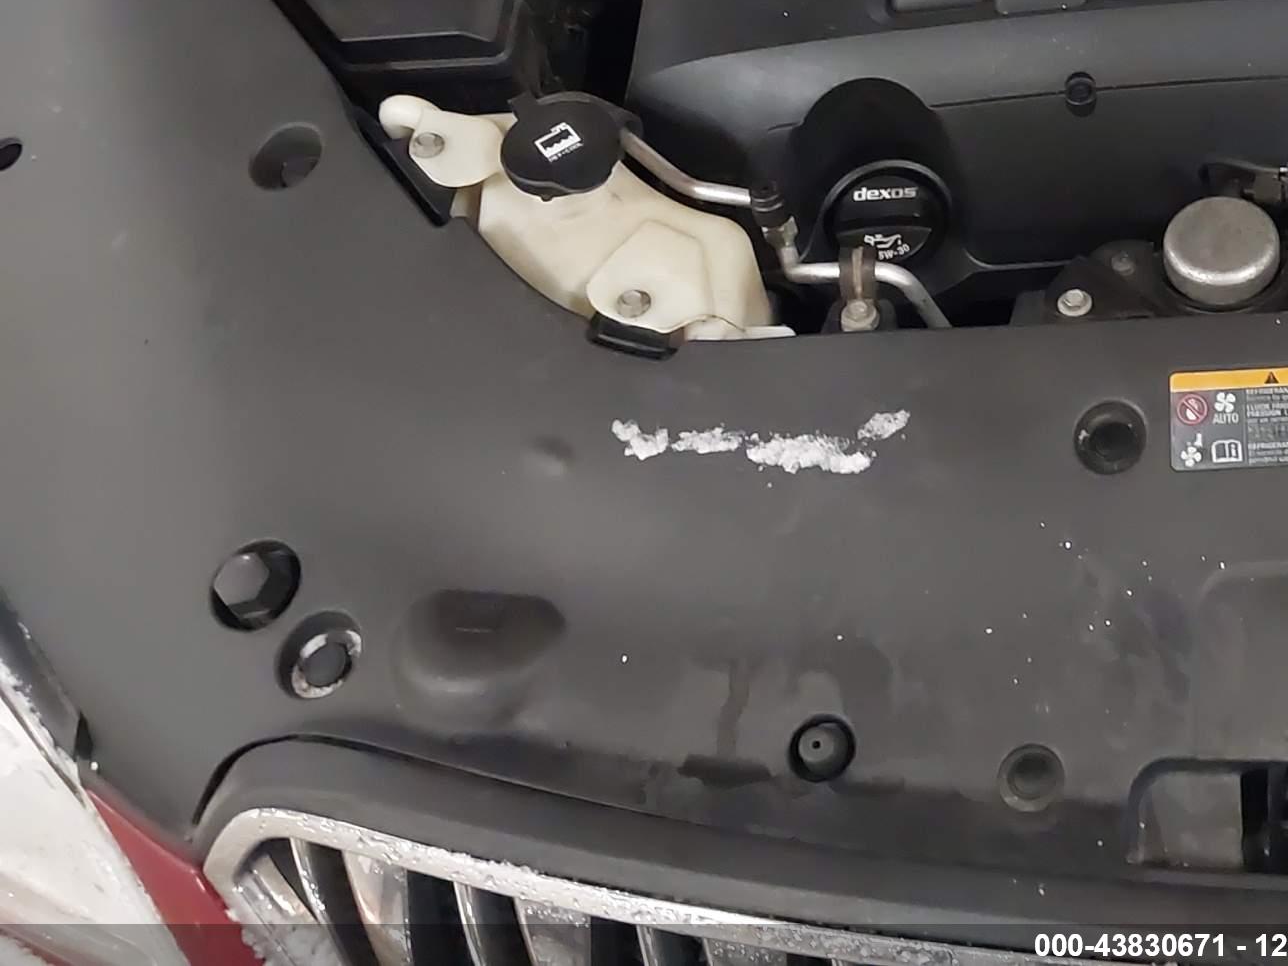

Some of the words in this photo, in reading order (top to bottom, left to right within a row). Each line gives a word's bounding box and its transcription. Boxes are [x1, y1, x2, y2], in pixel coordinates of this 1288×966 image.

[853, 186, 918, 202] dexos
[878, 243, 911, 260] 5W-30
[1212, 412, 1239, 425] AUTO
